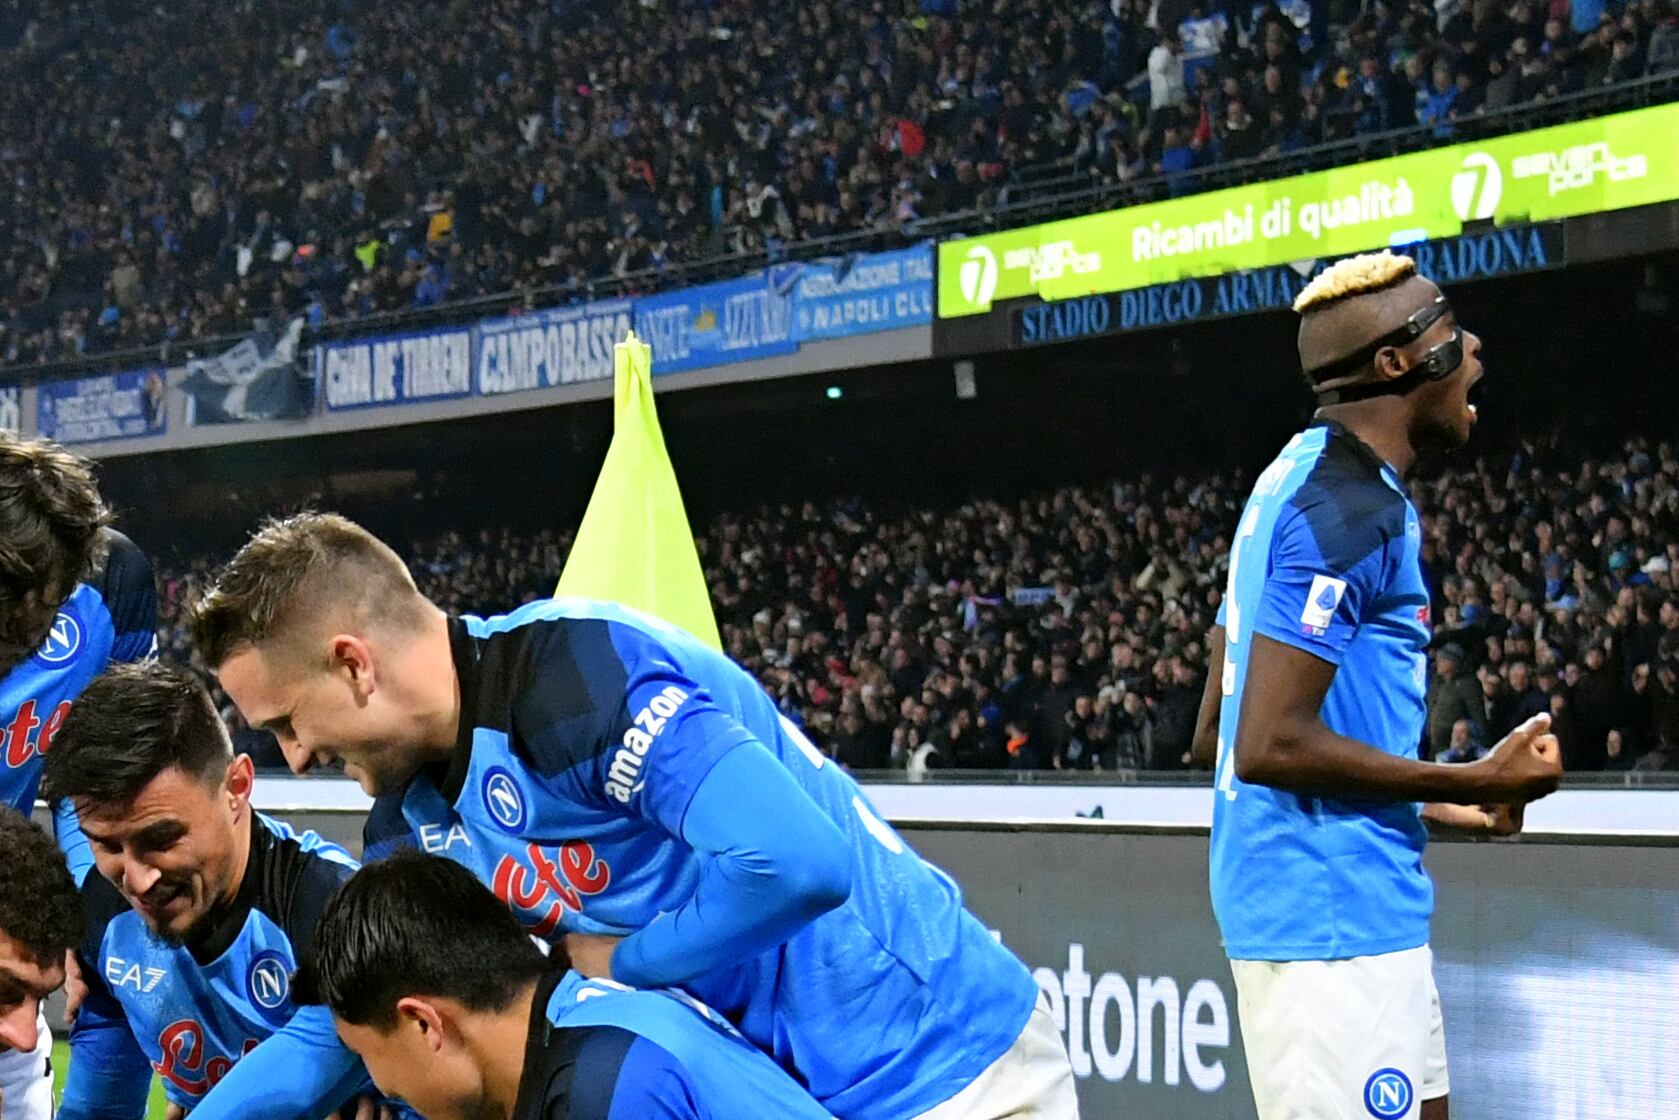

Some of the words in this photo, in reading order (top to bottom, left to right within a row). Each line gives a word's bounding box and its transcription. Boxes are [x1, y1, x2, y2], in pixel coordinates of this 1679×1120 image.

[1131, 207, 1254, 263] Ricambi
[1261, 198, 1292, 240] di
[1298, 178, 1415, 241] qualità
[1022, 297, 1110, 344] STADIO
[1119, 280, 1202, 334] DIEGO
[1209, 268, 1297, 316] ARMA
[1417, 227, 1547, 283] RADONA
[604, 685, 689, 804] amazon
[490, 780, 519, 820] N
[105, 956, 167, 993] EA7
[257, 968, 281, 999] N
[1377, 1080, 1401, 1108] N
